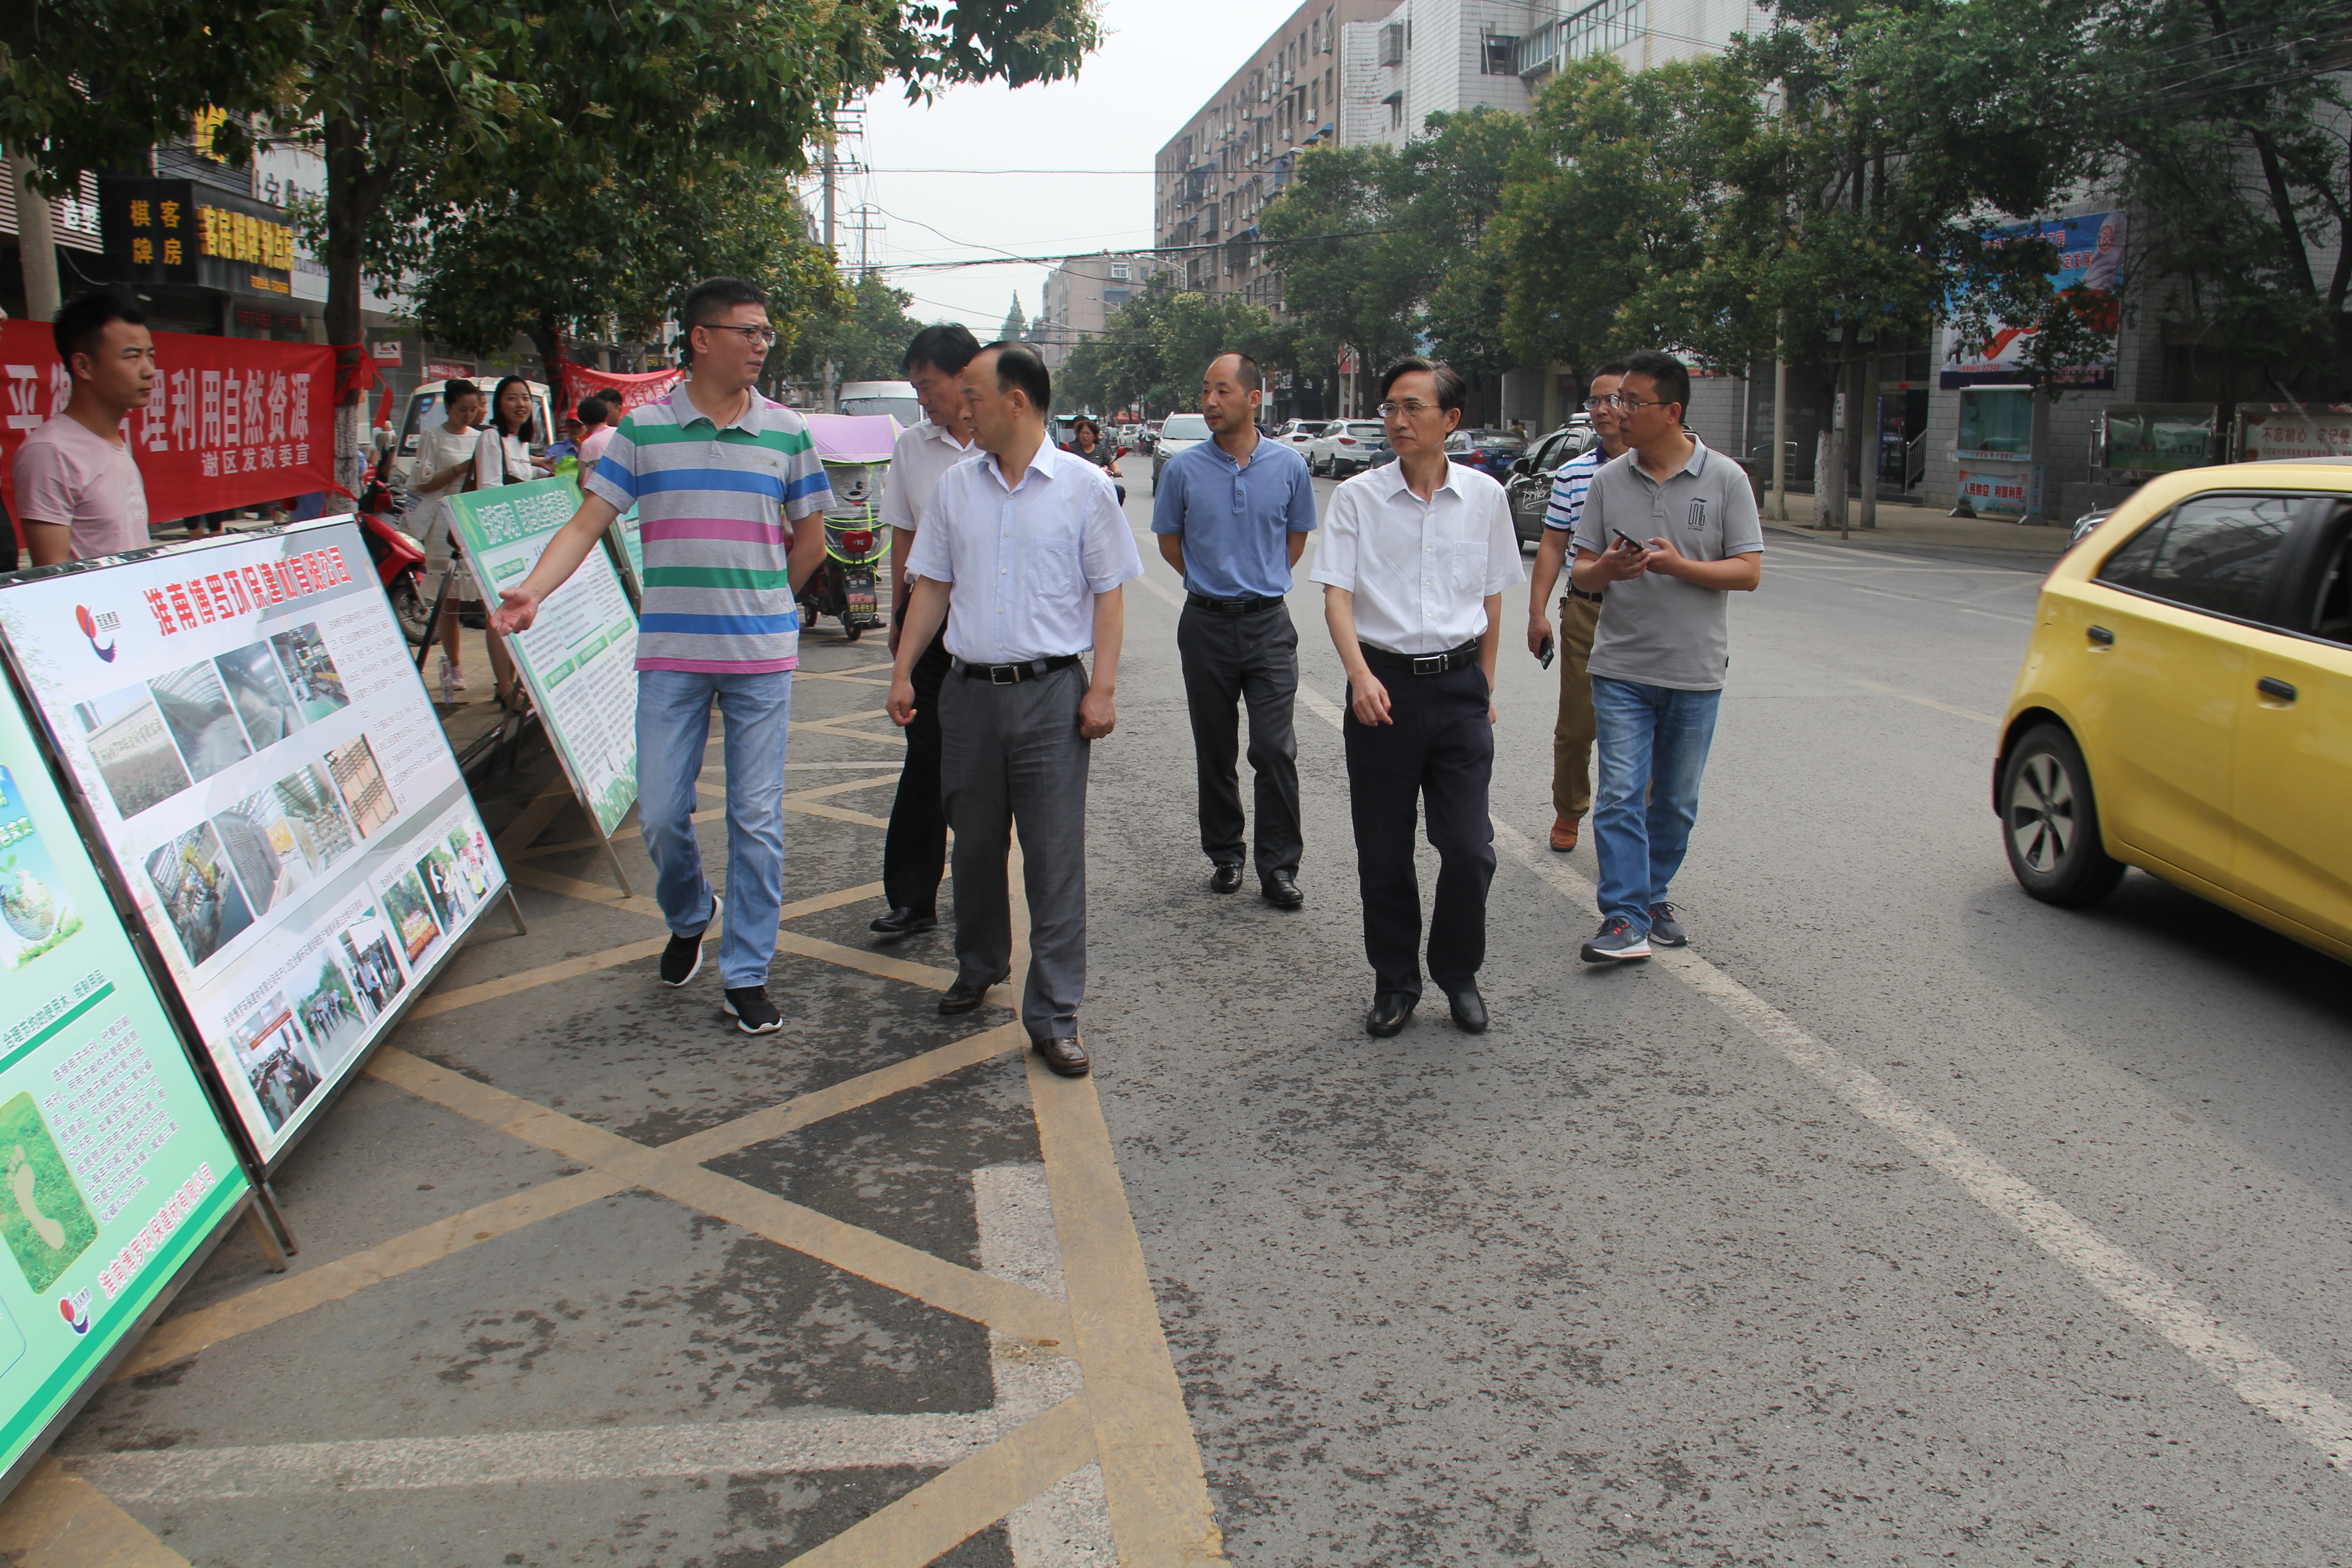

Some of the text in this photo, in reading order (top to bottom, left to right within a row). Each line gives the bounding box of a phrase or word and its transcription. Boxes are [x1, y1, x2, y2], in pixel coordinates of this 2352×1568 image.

[2262, 427, 2307, 443] 不忘初心
[202, 442, 309, 477] 谢区发改委宣
[1963, 482, 1989, 497] 人民防空
[1994, 485, 2023, 499] 利国利民
[142, 545, 353, 637] 淮南博罗环保建材有限公司
[97, 1162, 216, 1299] 淮南博罗环保建材有限公司
